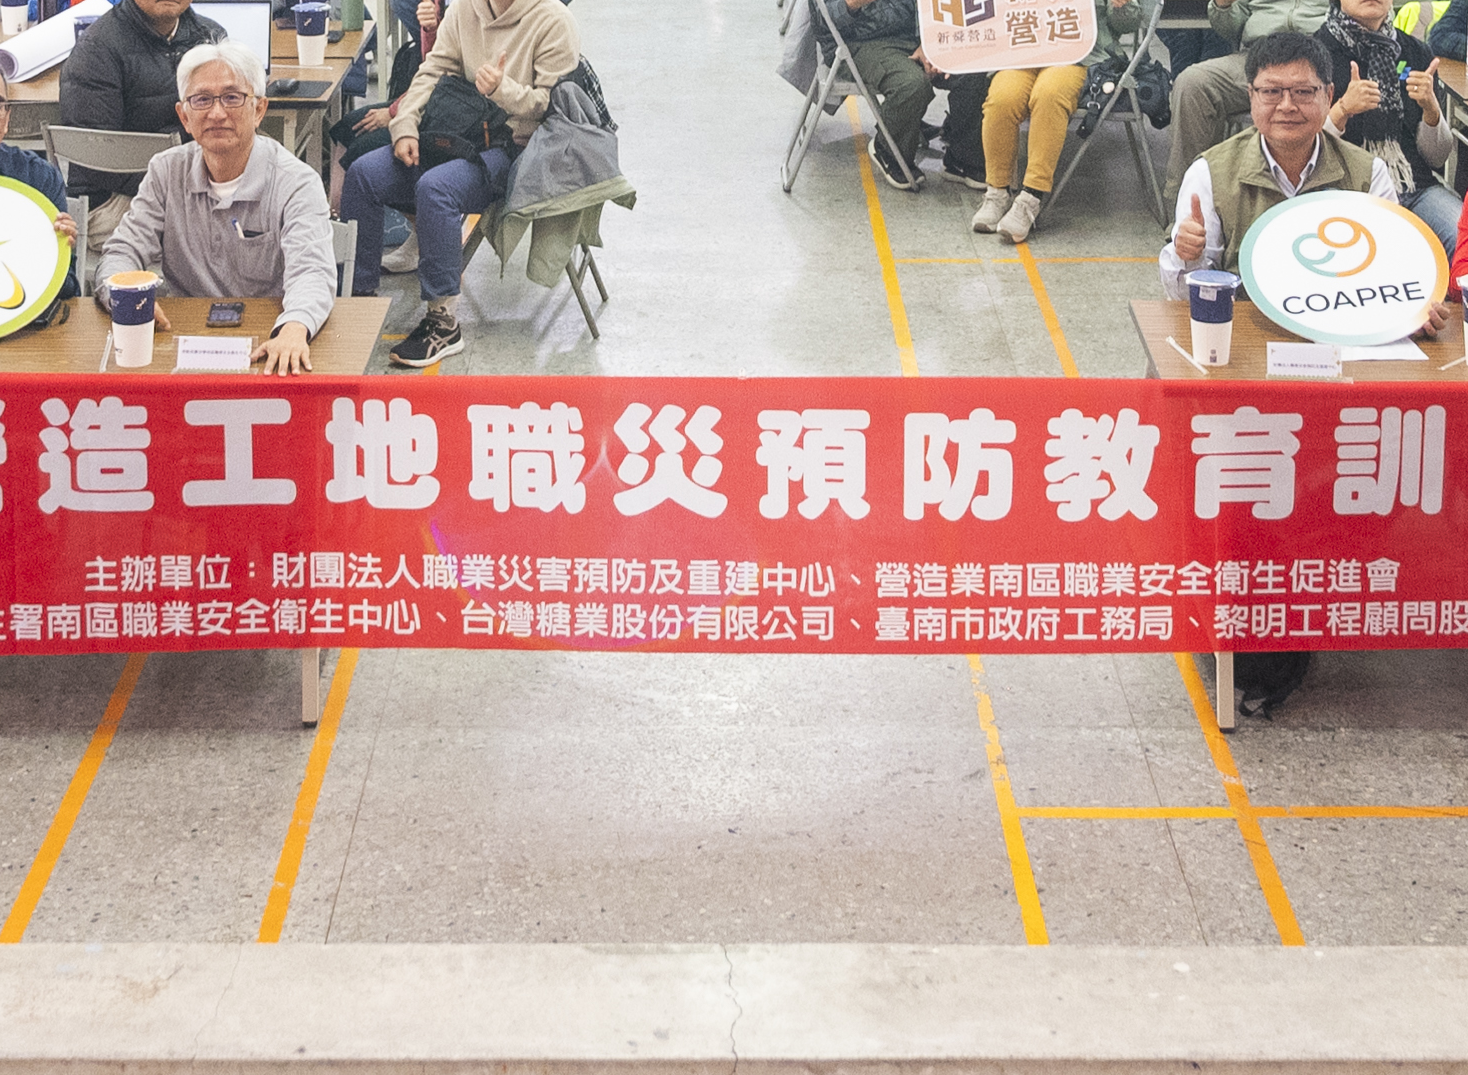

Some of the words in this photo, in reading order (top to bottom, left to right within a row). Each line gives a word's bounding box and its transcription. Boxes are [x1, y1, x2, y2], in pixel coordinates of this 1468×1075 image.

[937, 28, 997, 45] 新舜營造
[1005, 7, 1081, 47] 營造
[1282, 280, 1426, 315] COAPRE
